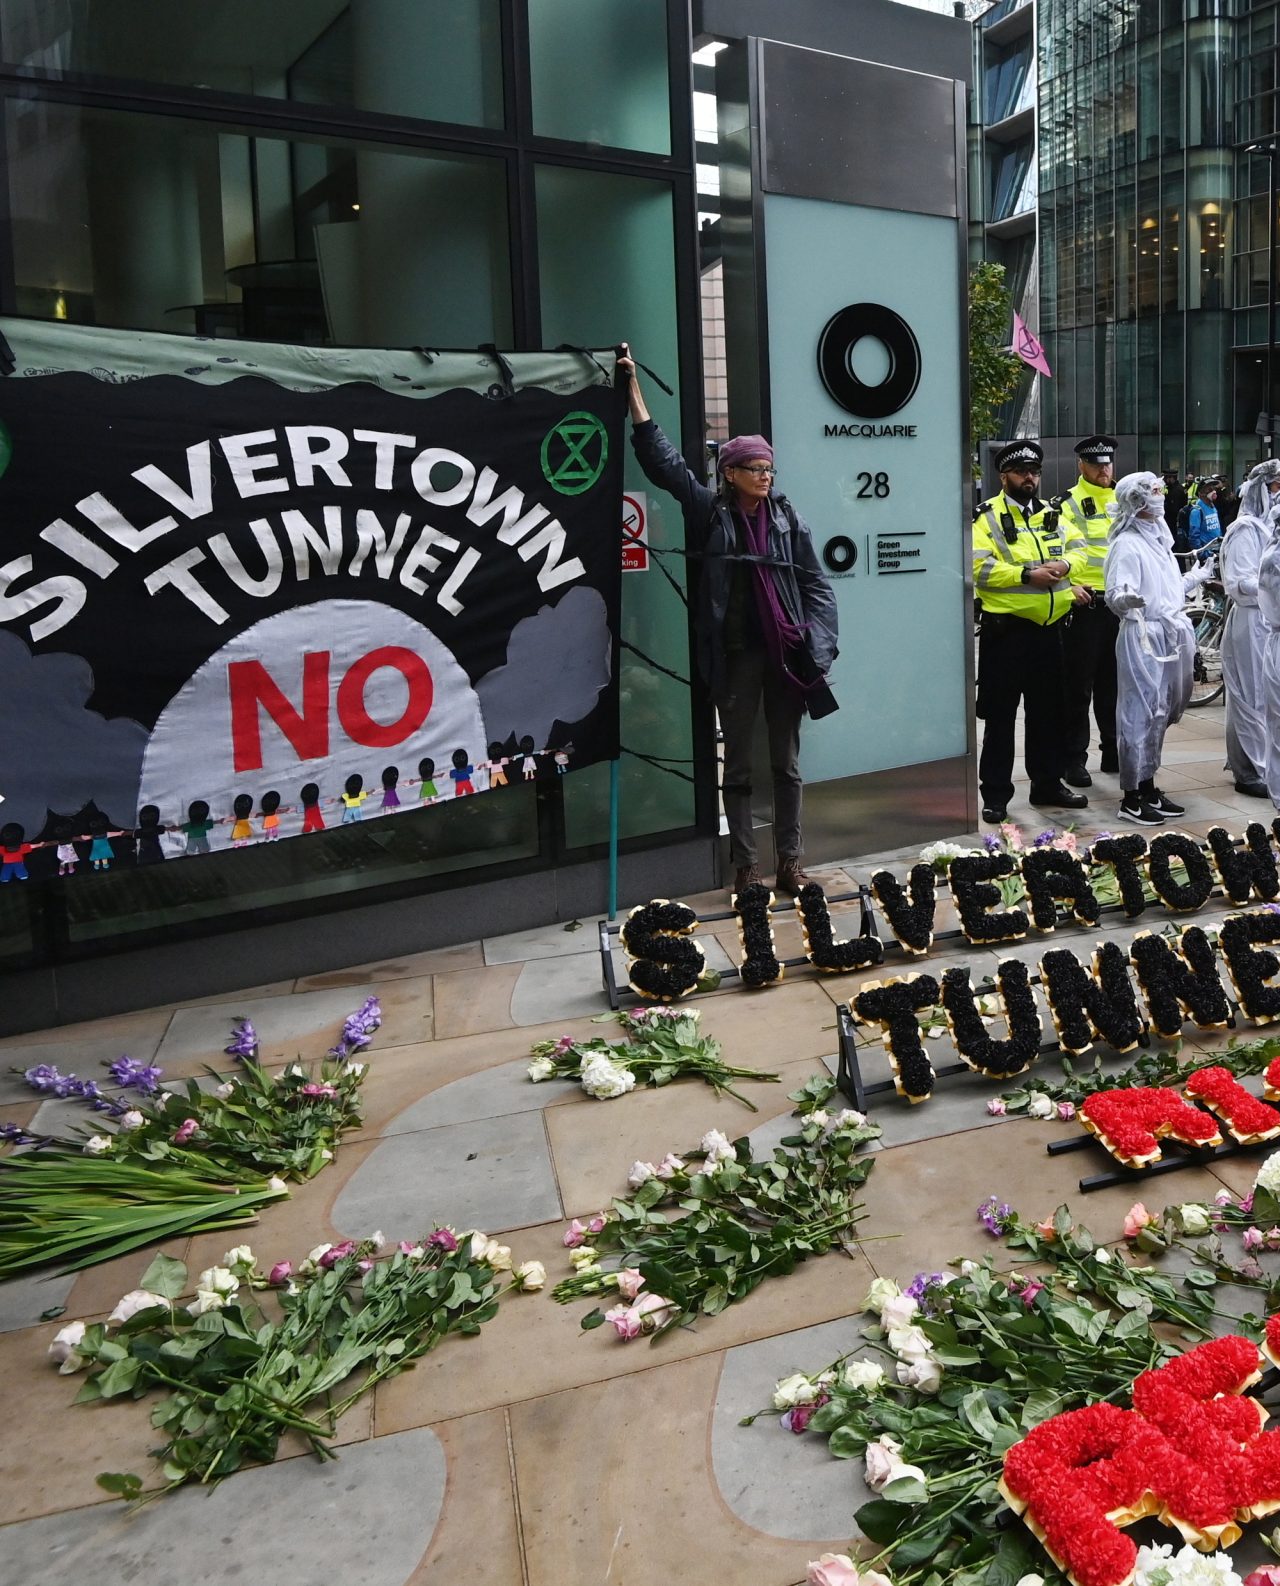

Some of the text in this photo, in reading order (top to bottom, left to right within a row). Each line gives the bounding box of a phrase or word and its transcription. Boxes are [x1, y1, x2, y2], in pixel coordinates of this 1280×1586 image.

[824, 424, 918, 438] MACQUARIE
[856, 471, 890, 499] 28
[0, 425, 587, 643] SILVERTOWN
[877, 541, 900, 549] Green
[877, 549, 920, 559] Investment
[143, 505, 483, 626] TUNNEL
[878, 560, 900, 569] Group
[226, 645, 434, 772] NO
